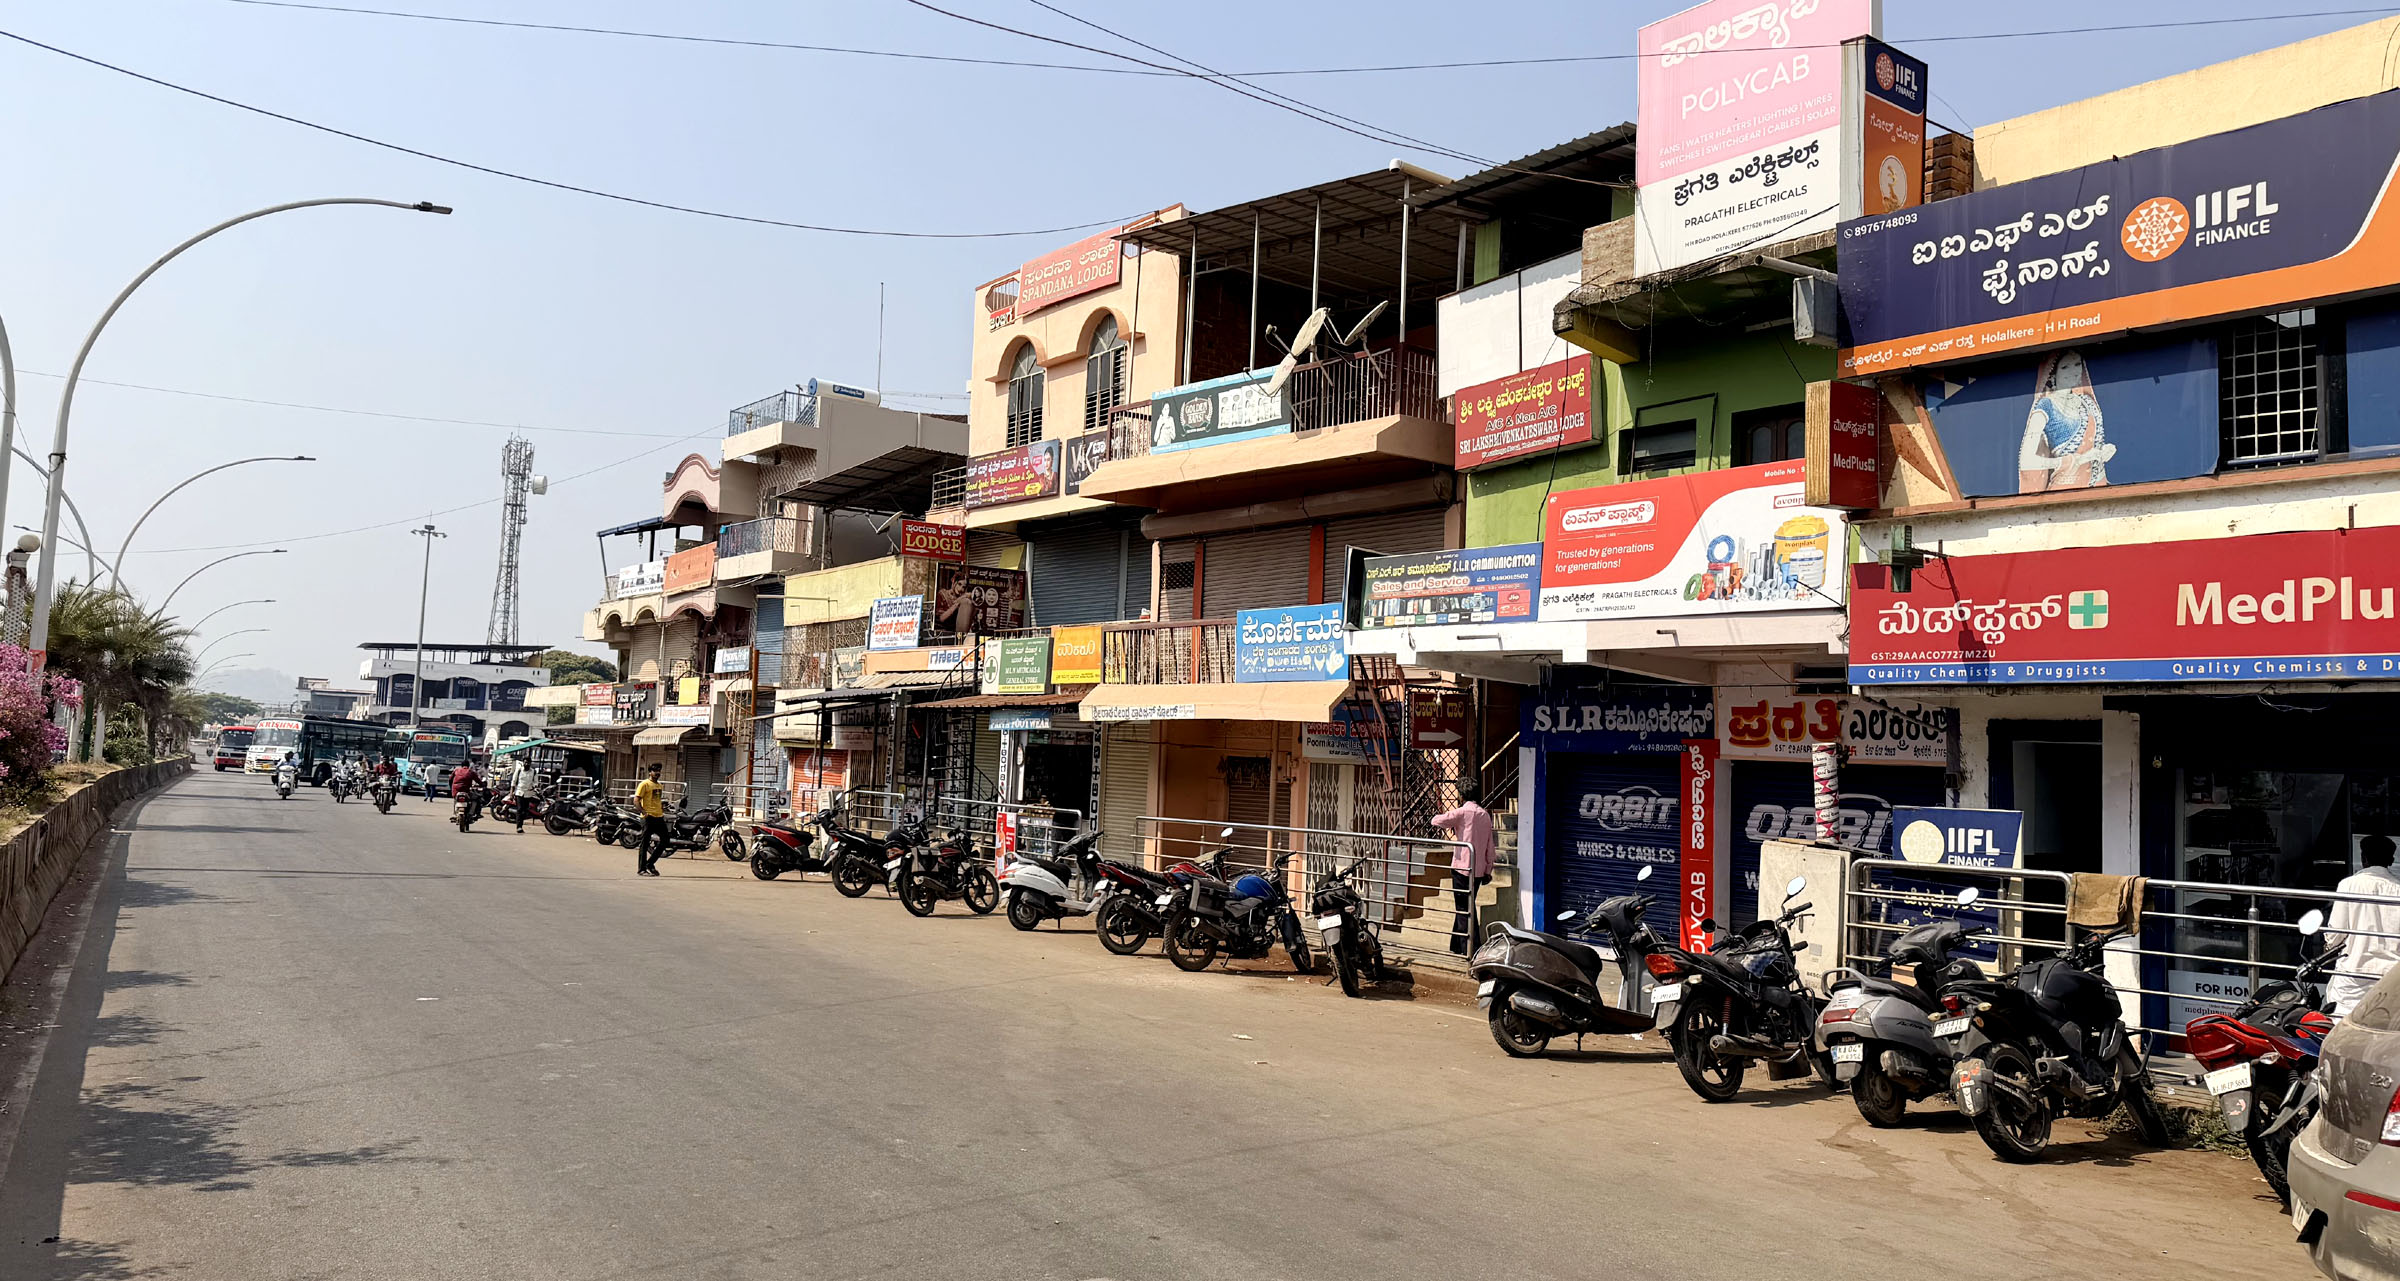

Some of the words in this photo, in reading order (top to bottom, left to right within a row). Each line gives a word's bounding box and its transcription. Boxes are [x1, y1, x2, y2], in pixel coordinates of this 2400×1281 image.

[1682, 54, 1810, 119] POLYCAB
[1896, 64, 1918, 91] IIFL
[1895, 84, 1916, 101] FINANCE
[1659, 144, 1681, 157] FANS
[1686, 133, 1714, 148] WATER
[1716, 120, 1751, 141] HEATERS
[1758, 105, 1798, 127] LIGHTING
[1804, 93, 1833, 109] WIRES
[1659, 150, 1700, 169] SWITCHES
[1706, 130, 1761, 154] SWITCHGEAR
[1767, 117, 1801, 134] CABLES
[1806, 105, 1836, 121] SOLAR
[1674, 172, 1719, 207] ಪ್ರಗತಿ
[1729, 139, 1819, 187] ಎಲೆಕ್ಟ್ರಿಕಲ್ಸ್
[1684, 206, 1735, 228] PRAGATHI
[1737, 185, 1808, 213] ELECTRICALS
[2195, 181, 2279, 228] IIFL
[1853, 212, 1918, 237] 8976748093
[2195, 219, 2271, 247] FINANCE
[1022, 274, 1074, 304] SPANDANA
[1077, 260, 1114, 285] LODGE
[1981, 326, 2034, 345] Holalkere
[2045, 322, 2054, 333] H
[2058, 320, 2067, 331] H
[2070, 313, 2101, 328] Road
[1460, 400, 1473, 423] ಶ್ರೀ
[1485, 418, 1503, 432] A/C
[1505, 415, 1514, 426] &
[1516, 412, 1536, 424] Non
[1538, 405, 1557, 419] A/C
[1460, 438, 1471, 454] SRI
[1560, 412, 1584, 431] LODGE
[1764, 468, 1785, 477] Mobile
[1786, 467, 1796, 475] No
[1833, 453, 1868, 471] MedPlus
[1565, 508, 1606, 525] ಏವನ್
[905, 533, 962, 552] LODGE
[1557, 548, 1588, 559] Trusted
[1589, 546, 1600, 557] by
[1601, 543, 1654, 557] generations
[1555, 564, 1568, 573] for
[1568, 558, 1621, 574] generations!
[1372, 582, 1402, 592] Sales
[1403, 579, 1425, 590] and
[1426, 575, 1470, 588] Service
[1602, 591, 1633, 600] PRAGATHI
[1634, 588, 1678, 597] ELECTRICALS
[2176, 576, 2400, 626] MedPlu
[1868, 668, 1921, 680] Quality
[1930, 667, 1998, 678] Chemists
[2008, 666, 2016, 676] &
[2026, 665, 2107, 678] Druggists
[2172, 662, 2241, 675] Quality
[2253, 660, 2343, 673] Chemists
[2357, 660, 2368, 671] &
[259, 721, 300, 729] KRISHNA
[1011, 717, 1050, 728] FOOTWEAR
[1533, 705, 1603, 734] S.L.R
[1728, 699, 1841, 748] ಪ್ರಗತಿ
[1579, 794, 1680, 824] ORBIT
[1577, 841, 1614, 858] WIRES
[1616, 844, 1626, 859] &
[1628, 845, 1676, 863] CABLES
[1948, 828, 2000, 855] IIFL
[1948, 855, 1995, 867] FINANCE
[1691, 872, 1706, 954] OLYCAB
[2195, 982, 2220, 994] FOR
